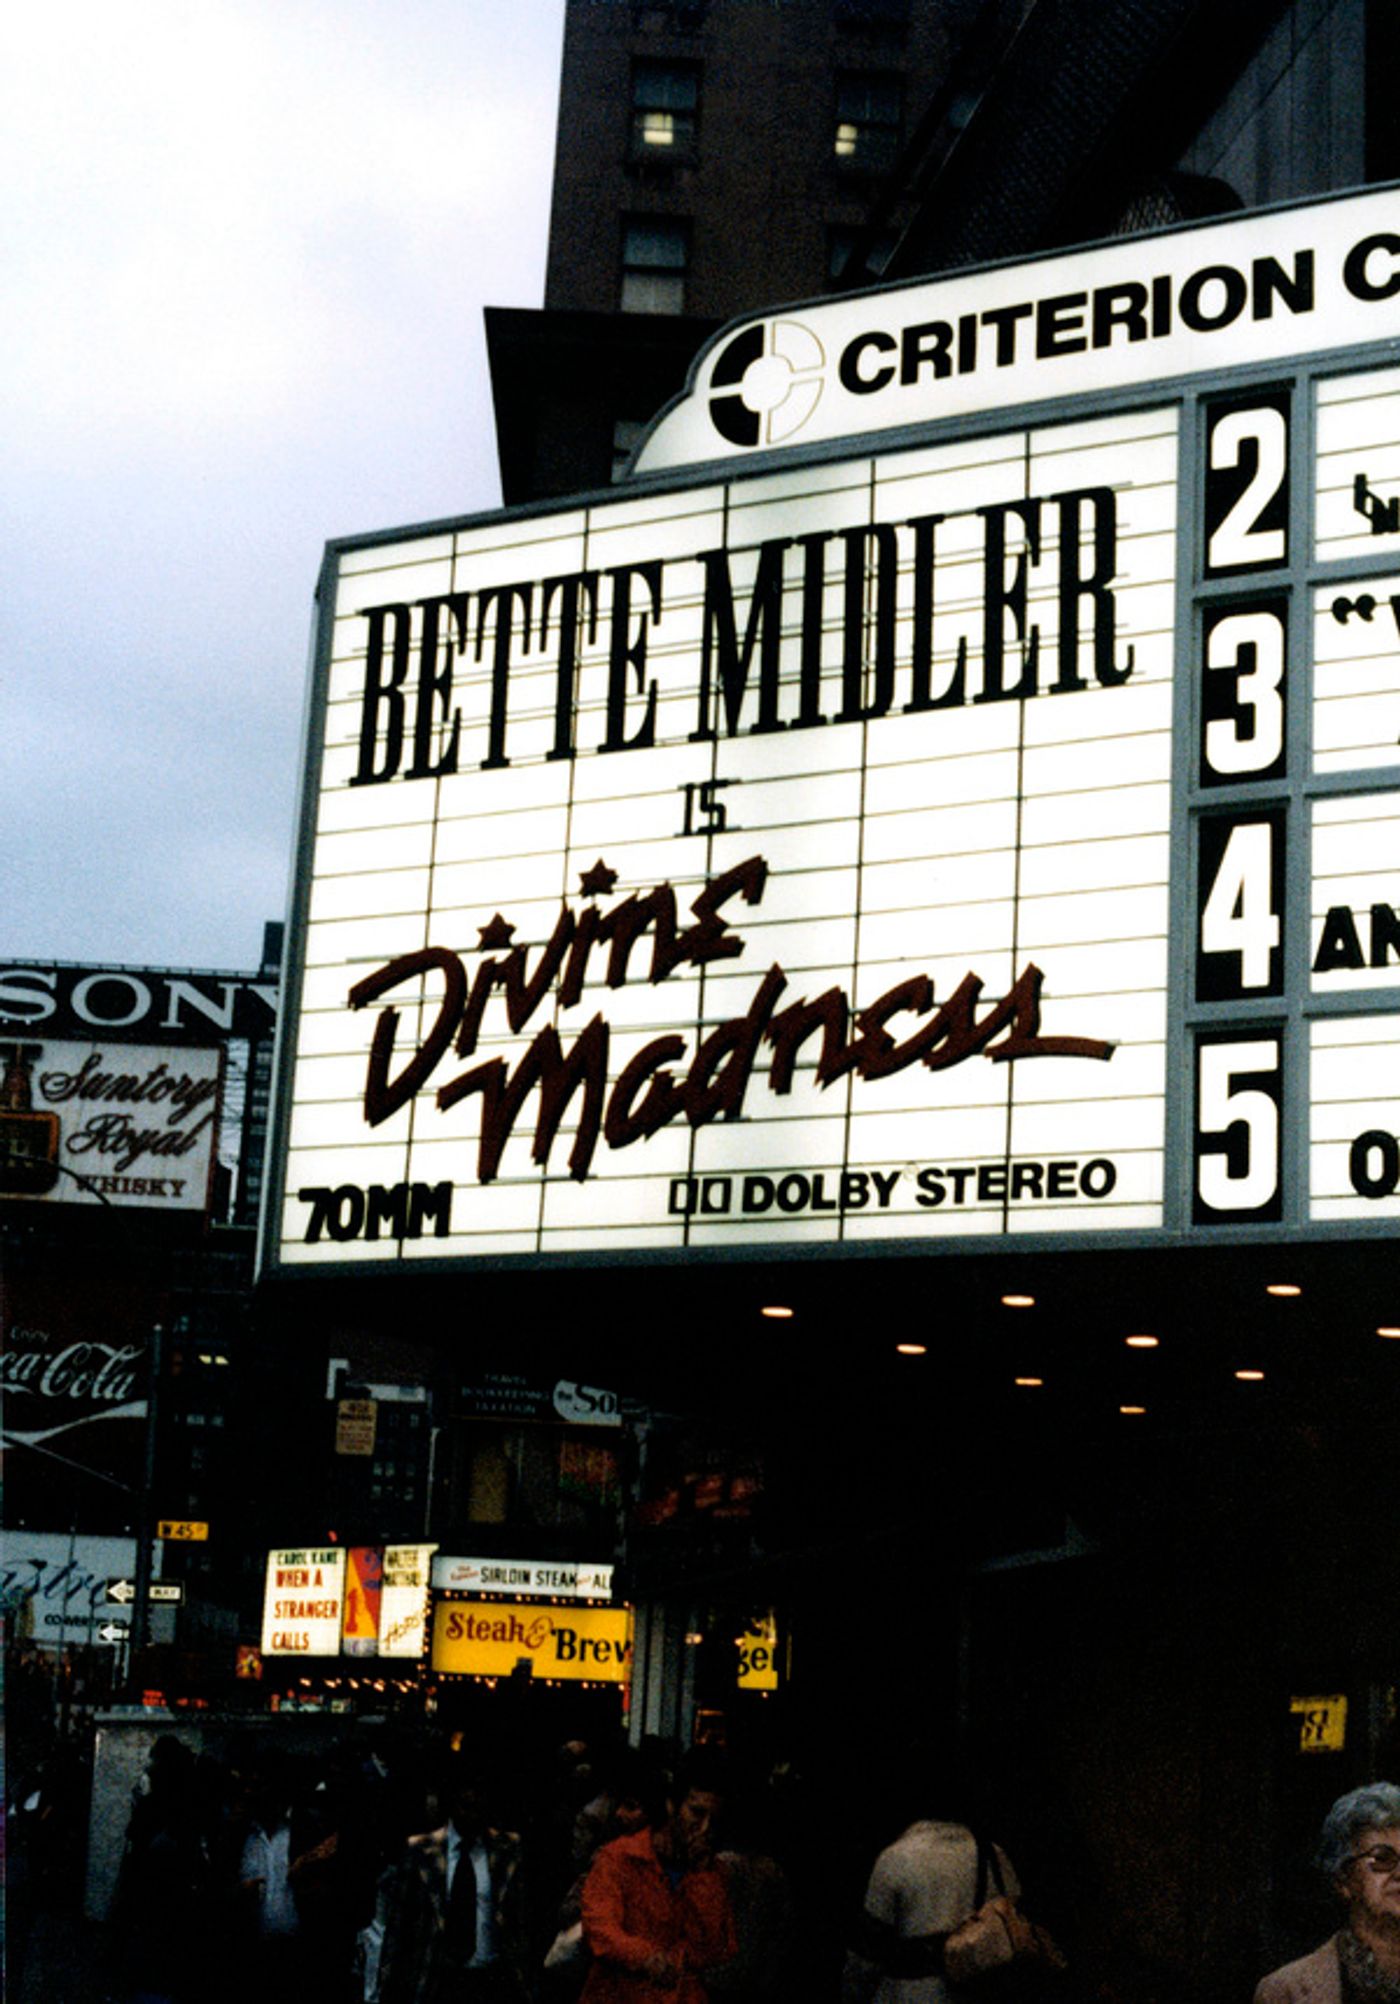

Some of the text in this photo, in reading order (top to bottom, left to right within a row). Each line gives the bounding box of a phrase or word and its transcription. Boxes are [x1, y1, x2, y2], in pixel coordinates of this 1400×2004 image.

[838, 249, 1315, 395] CRITERION
[1208, 406, 1286, 568] 2
[349, 486, 1135, 787] BETTE MIDLER
[1205, 611, 1285, 775] 3
[681, 779, 733, 836] IS
[1201, 822, 1281, 989] 4
[349, 855, 768, 1127] Divine
[40, 1053, 219, 1126] Suntory
[437, 962, 1121, 1185] Madness
[65, 1109, 217, 1172] Royal
[1198, 1040, 1279, 1211] 5
[76, 1175, 188, 1198] WHISKY
[297, 1180, 453, 1245] 70MM
[742, 1158, 1118, 1216] DOLBY STEREO
[275, 1568, 324, 1588] WHEN A
[480, 1566, 531, 1586] SIRLOIN
[271, 1631, 310, 1651] CALLS
[273, 1600, 339, 1620] STRANGER
[445, 1611, 526, 1644] Steak
